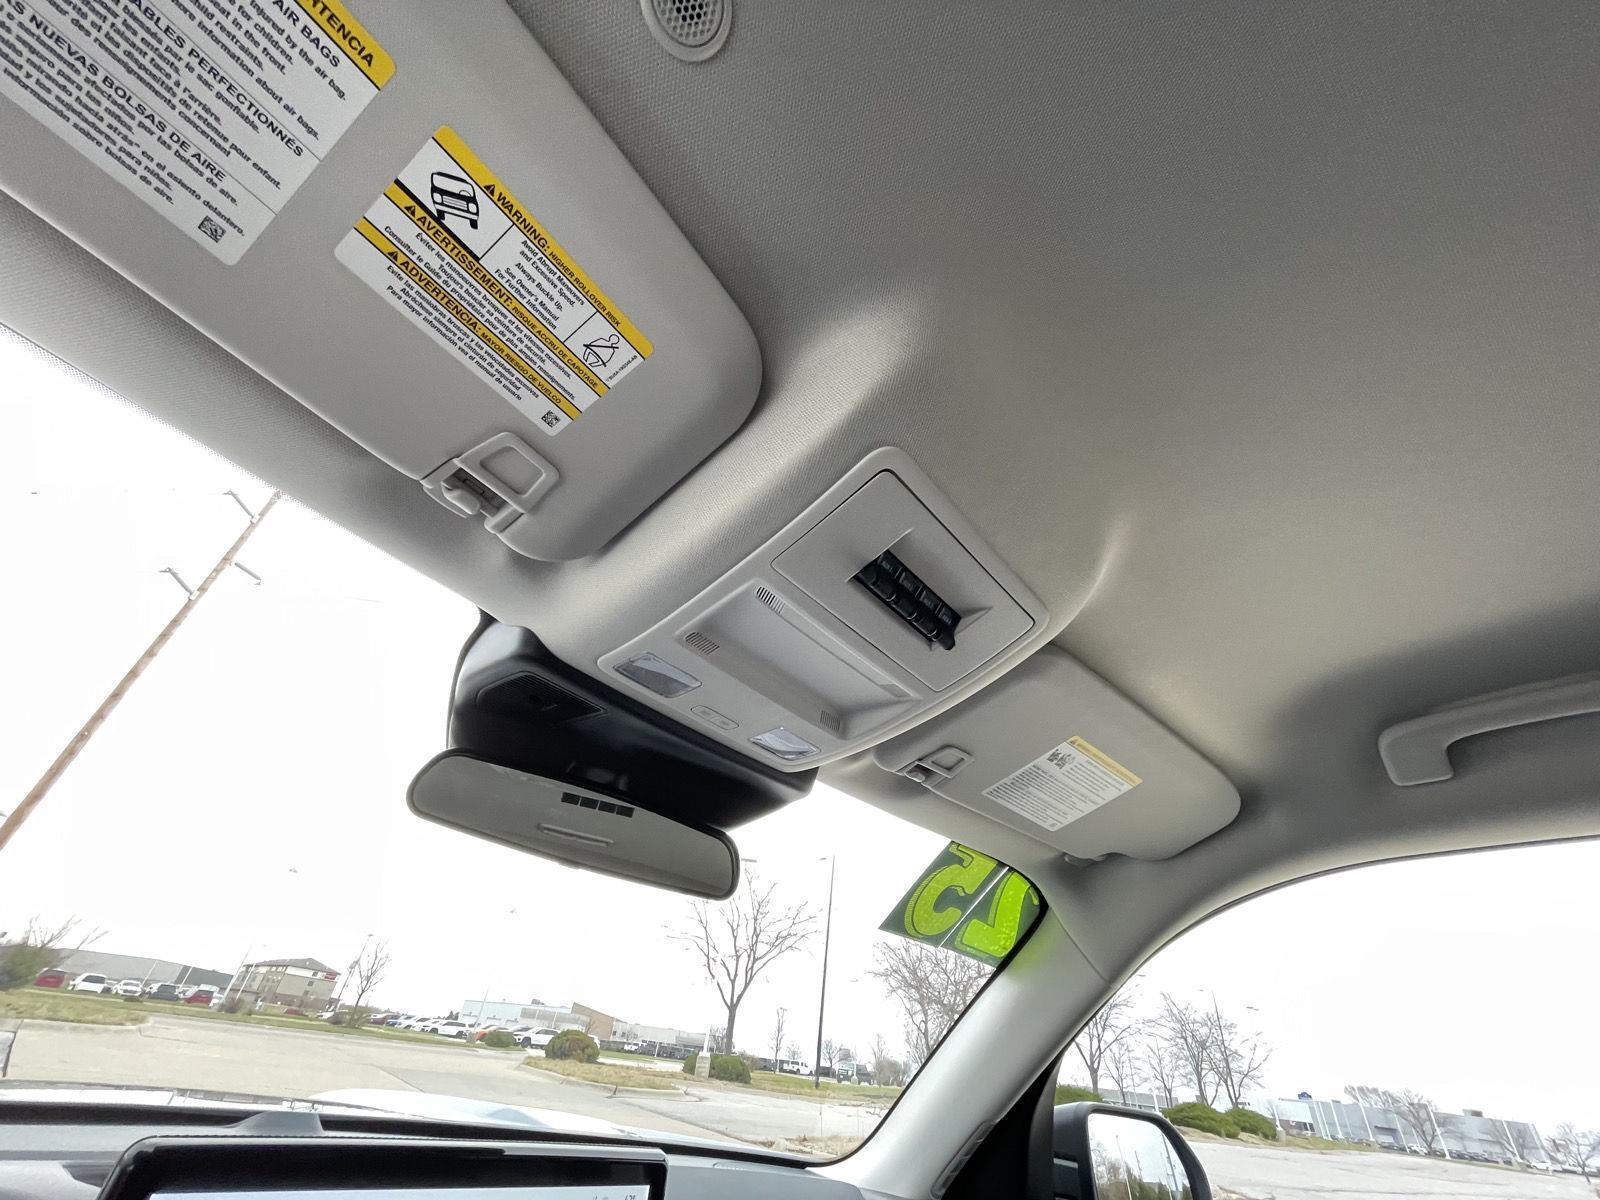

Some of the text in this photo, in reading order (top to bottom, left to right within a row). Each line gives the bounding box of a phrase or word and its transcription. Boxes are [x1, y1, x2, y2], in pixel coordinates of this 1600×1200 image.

[14, 34, 55, 69] seguro
[56, 68, 83, 92] para
[103, 106, 135, 135] niños.
[70, 17, 231, 157] des renseignements concernant
[109, 21, 148, 59] faisant
[149, 57, 172, 80] face
[173, 79, 181, 89] à
[121, 18, 181, 77] les enfants.
[121, 4, 260, 134] blessés par le sac gonflable.
[197, 20, 255, 77] information
[255, 77, 283, 104] about
[282, 103, 297, 116] air
[296, 114, 319, 141] bags.
[214, 20, 264, 71] restraints.
[231, 17, 286, 75] in the front.
[237, 4, 293, 65] for children.
[284, 34, 298, 50] by
[298, 47, 314, 66] the
[314, 66, 329, 79] air
[328, 78, 346, 101] bag.
[300, 24, 340, 67] BAGS
[3, 67, 174, 205] información sobre bolsas de aire.
[23, 70, 33, 79] y
[54, 94, 117, 147] sujetadores
[118, 145, 142, 166] para
[143, 165, 172, 191] niños.
[25, 57, 73, 97] mirando
[74, 95, 105, 123] hacia
[141, 150, 154, 163] en
[155, 162, 167, 172] el
[166, 171, 202, 200] asiento
[202, 199, 245, 237] delantero.
[28, 14, 226, 182] NUEVAS BOLSAS DE AIRE
[83, 75, 136, 121] afectados
[137, 120, 156, 136] por
[156, 134, 172, 151] las
[173, 148, 204, 177] bolsas
[205, 177, 218, 188] de
[218, 188, 238, 206] aire.
[90, 20, 280, 190] et les dispositifs de retenue pour enfant.
[187, 47, 303, 157] PERFECTIONNÉS
[384, 225, 575, 401] Consulter le Guide du propriétaire pour de plus amples renseignements.
[415, 232, 436, 252] Éviter
[434, 250, 446, 262] les
[481, 293, 508, 320] brusques
[513, 324, 524, 334] les
[523, 332, 545, 354] vitesses
[416, 215, 513, 307] AVERTISSEMENT:
[511, 306, 537, 331] RISQUE
[535, 330, 559, 351] ACCRU
[557, 349, 568, 360] DE
[566, 358, 598, 389] CAPOTAGE
[438, 263, 546, 365] Toujours boucler sa ceinture de sécurité.
[494, 268, 557, 330] For Further Information
[496, 191, 550, 252] WARNING:
[548, 251, 575, 279] HIGHER
[573, 277, 607, 313] ROLLOVER
[605, 310, 621, 327] RISK
[504, 267, 560, 322] See Owner's Manual
[514, 262, 563, 312] Always Buckle Up.
[519, 250, 533, 263] and
[530, 260, 558, 289] Excessive
[521, 239, 585, 306] Avoid Abrupt Maneuvers
[386, 264, 404, 282] Evite
[403, 279, 415, 291] las
[414, 289, 447, 319] maniobras
[446, 317, 471, 339] bruscas
[474, 341, 484, 351] las
[484, 349, 515, 378] velocidades
[514, 376, 539, 399] excesivas
[386, 284, 403, 301] Para
[402, 299, 423, 317] mayor
[422, 315, 458, 347] información
[457, 345, 469, 356] vea
[474, 360, 496, 378] manual
[494, 377, 503, 385] de
[502, 383, 522, 401] usuario
[399, 260, 562, 404] ADVERTENCIA: MAYOR RIESGO DE VUELCO
[432, 315, 458, 337] siempre
[463, 342, 488, 363] cinturón
[486, 361, 495, 369] de
[494, 368, 521, 391] seguridad
